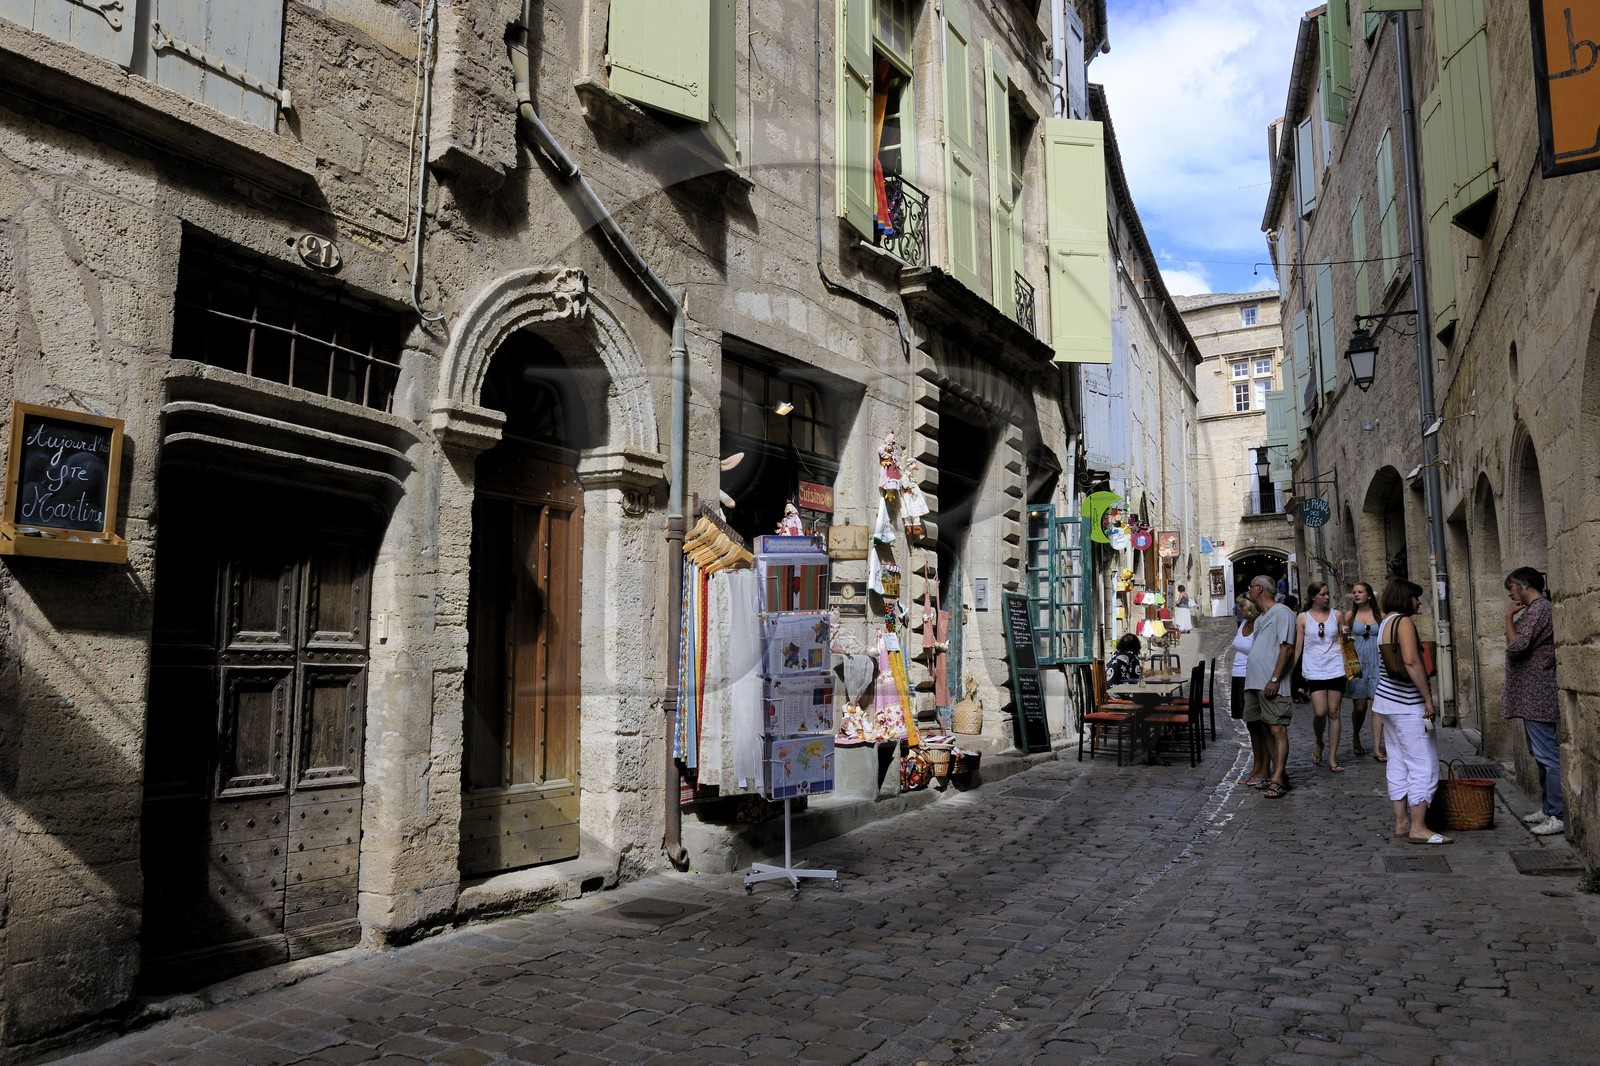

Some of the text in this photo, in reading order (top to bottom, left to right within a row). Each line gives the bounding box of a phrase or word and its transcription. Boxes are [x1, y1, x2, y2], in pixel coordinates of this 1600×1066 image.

[304, 236, 332, 267] 21
[1304, 499, 1329, 514] LE PHARE
[1306, 515, 1322, 527] ELFES
